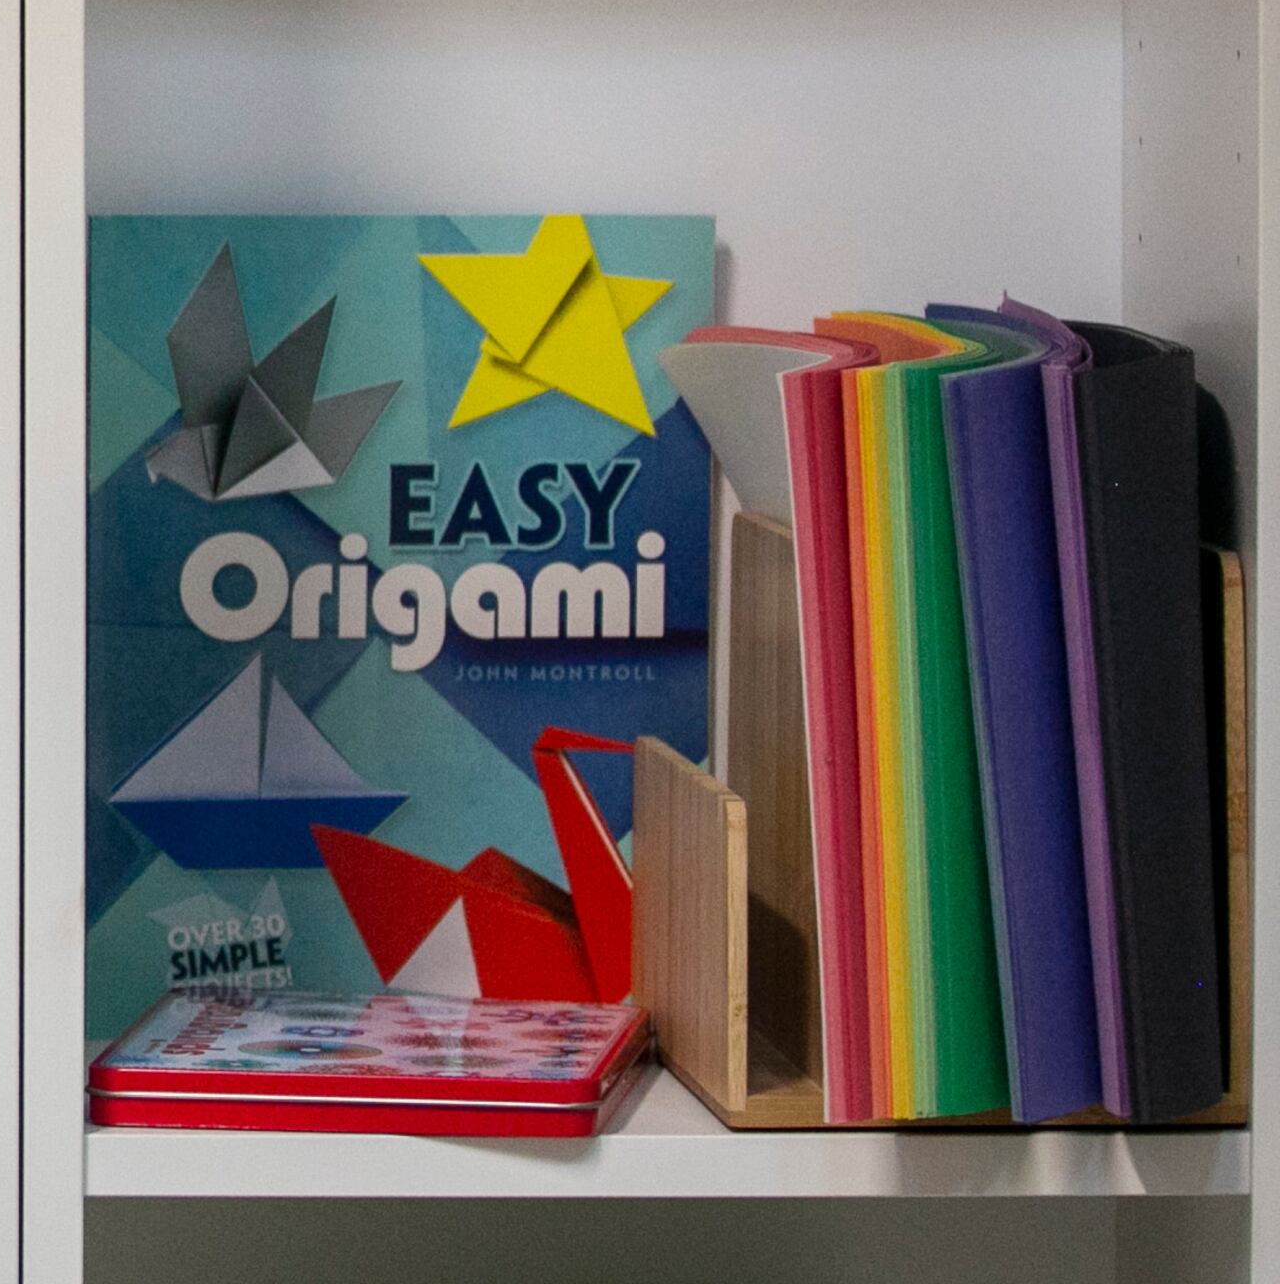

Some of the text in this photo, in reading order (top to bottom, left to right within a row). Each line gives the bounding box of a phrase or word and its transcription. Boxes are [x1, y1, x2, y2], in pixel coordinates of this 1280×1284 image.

[388, 460, 640, 551] EASY
[180, 531, 665, 672] Origami
[456, 664, 656, 681] JOHN MONTROLL
[169, 916, 285, 951] OVER 30
[170, 938, 285, 981] SIMPLE
